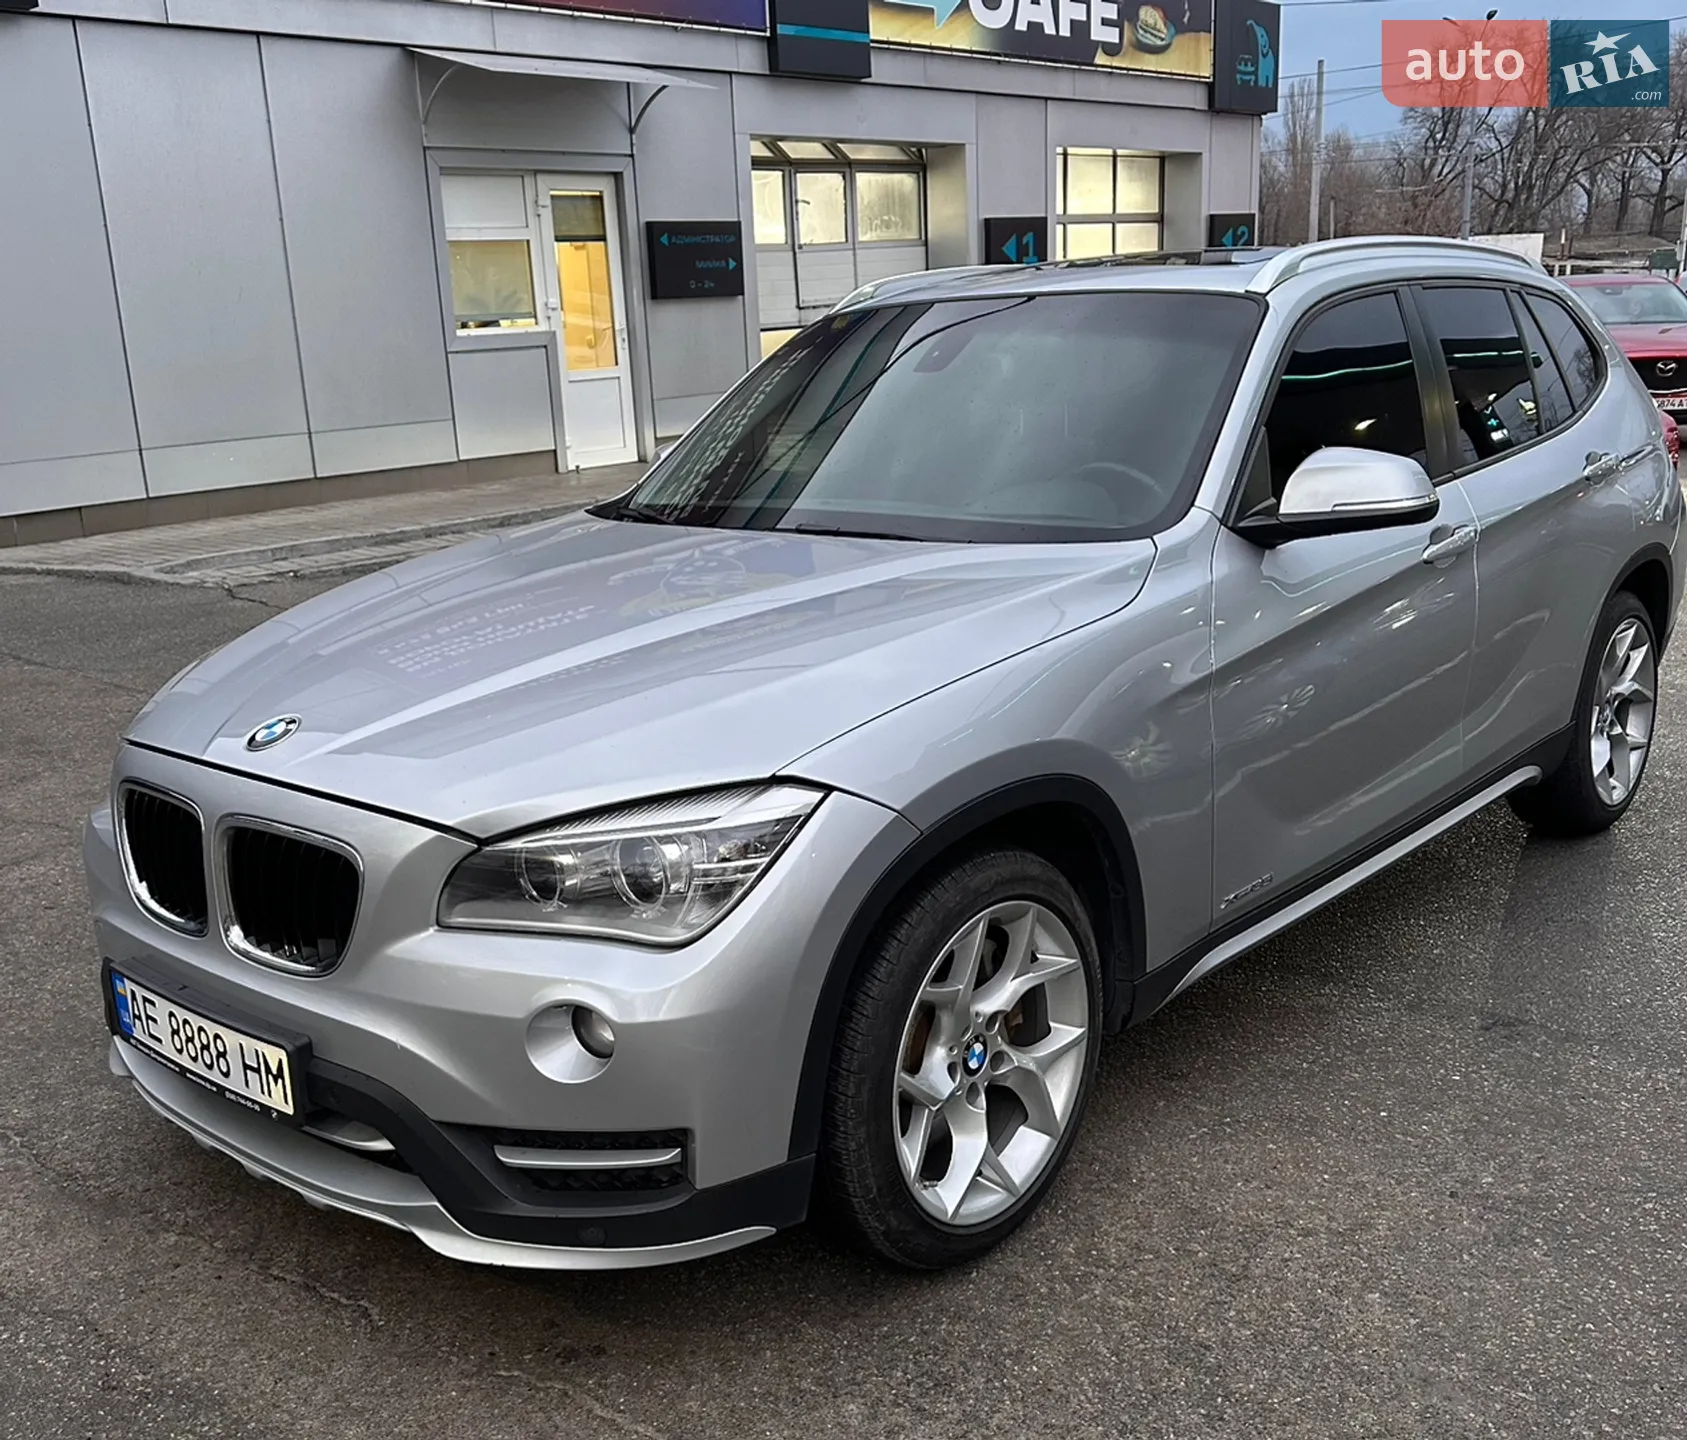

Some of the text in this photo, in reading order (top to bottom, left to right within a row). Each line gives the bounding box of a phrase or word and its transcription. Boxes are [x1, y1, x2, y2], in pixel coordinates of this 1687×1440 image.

[1022, 231, 1039, 265] 1
[1236, 226, 1249, 248] 2
[130, 988, 164, 1045] AE
[168, 1010, 231, 1079] 8888
[238, 1041, 289, 1107] HM
